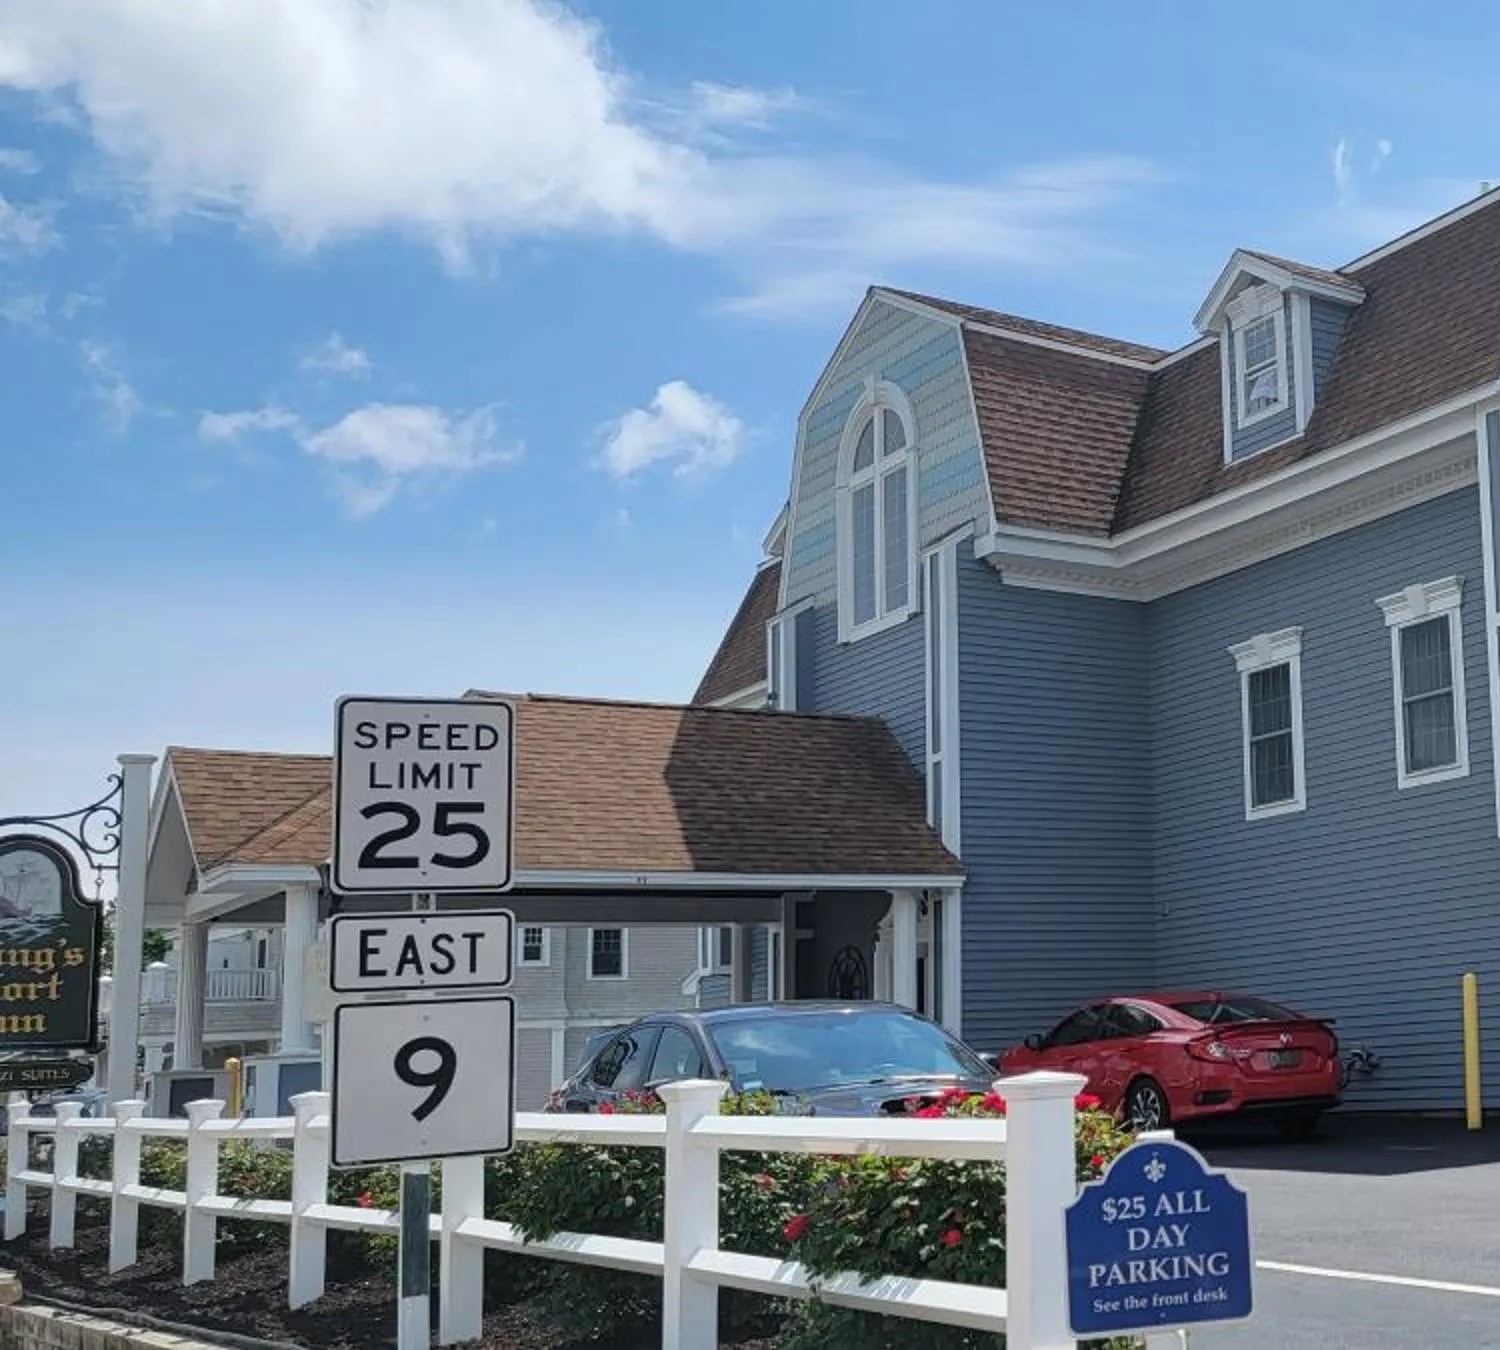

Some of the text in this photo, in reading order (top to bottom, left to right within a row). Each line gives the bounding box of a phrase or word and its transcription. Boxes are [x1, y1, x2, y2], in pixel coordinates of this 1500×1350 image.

[354, 721, 499, 752] SPEED
[369, 762, 483, 790] LIMIT
[358, 801, 491, 869] 25
[359, 928, 486, 978] EAST
[393, 1035, 458, 1123] 9
[1102, 1189, 1211, 1224] $25 ALL
[1126, 1223, 1190, 1251] DAY
[1088, 1251, 1230, 1288] PARKING
[1093, 1286, 1228, 1313] See the front desk
